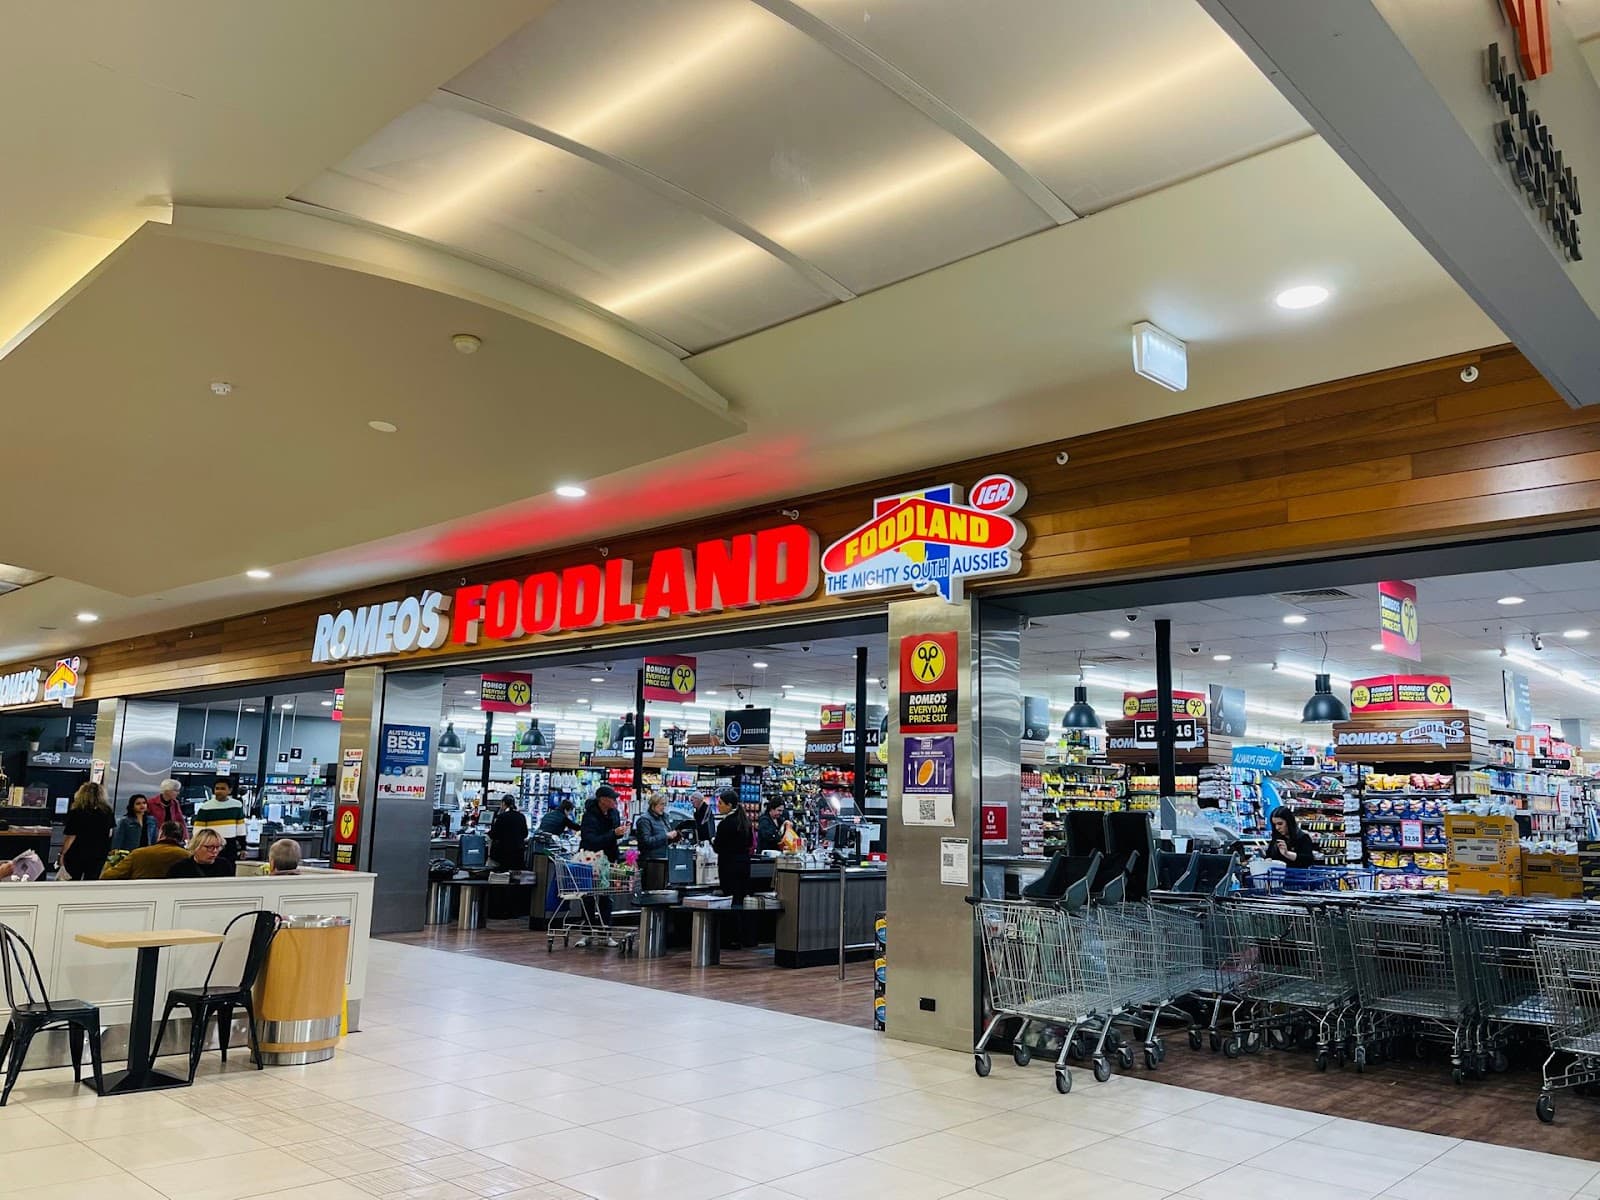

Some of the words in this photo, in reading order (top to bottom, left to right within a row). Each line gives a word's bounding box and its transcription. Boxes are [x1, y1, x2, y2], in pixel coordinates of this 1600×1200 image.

[844, 504, 990, 567] FOODLAND
[827, 574, 848, 592] THE
[852, 567, 900, 588] MIGHTY
[903, 557, 948, 581] SOUTH
[952, 550, 1009, 574] AUSSIES
[311, 589, 446, 663] ROMEO'S
[453, 524, 816, 643] FOODLAND
[0, 667, 41, 706] OMEO'S
[909, 693, 947, 705] ROMEO'S
[909, 705, 948, 714] EVERYDAY
[909, 714, 931, 723] PRICE
[932, 713, 948, 722] CUT
[844, 732, 855, 744] 13
[866, 732, 877, 743] 14
[1139, 724, 1156, 738] 15
[1175, 724, 1192, 737] 16
[1338, 731, 1398, 745] ROMEO'S
[1408, 723, 1457, 737] FOODLAND
[386, 735, 426, 750] BEST
[625, 740, 635, 750] 11
[643, 740, 654, 750] 12
[379, 784, 425, 794] FDLAND
